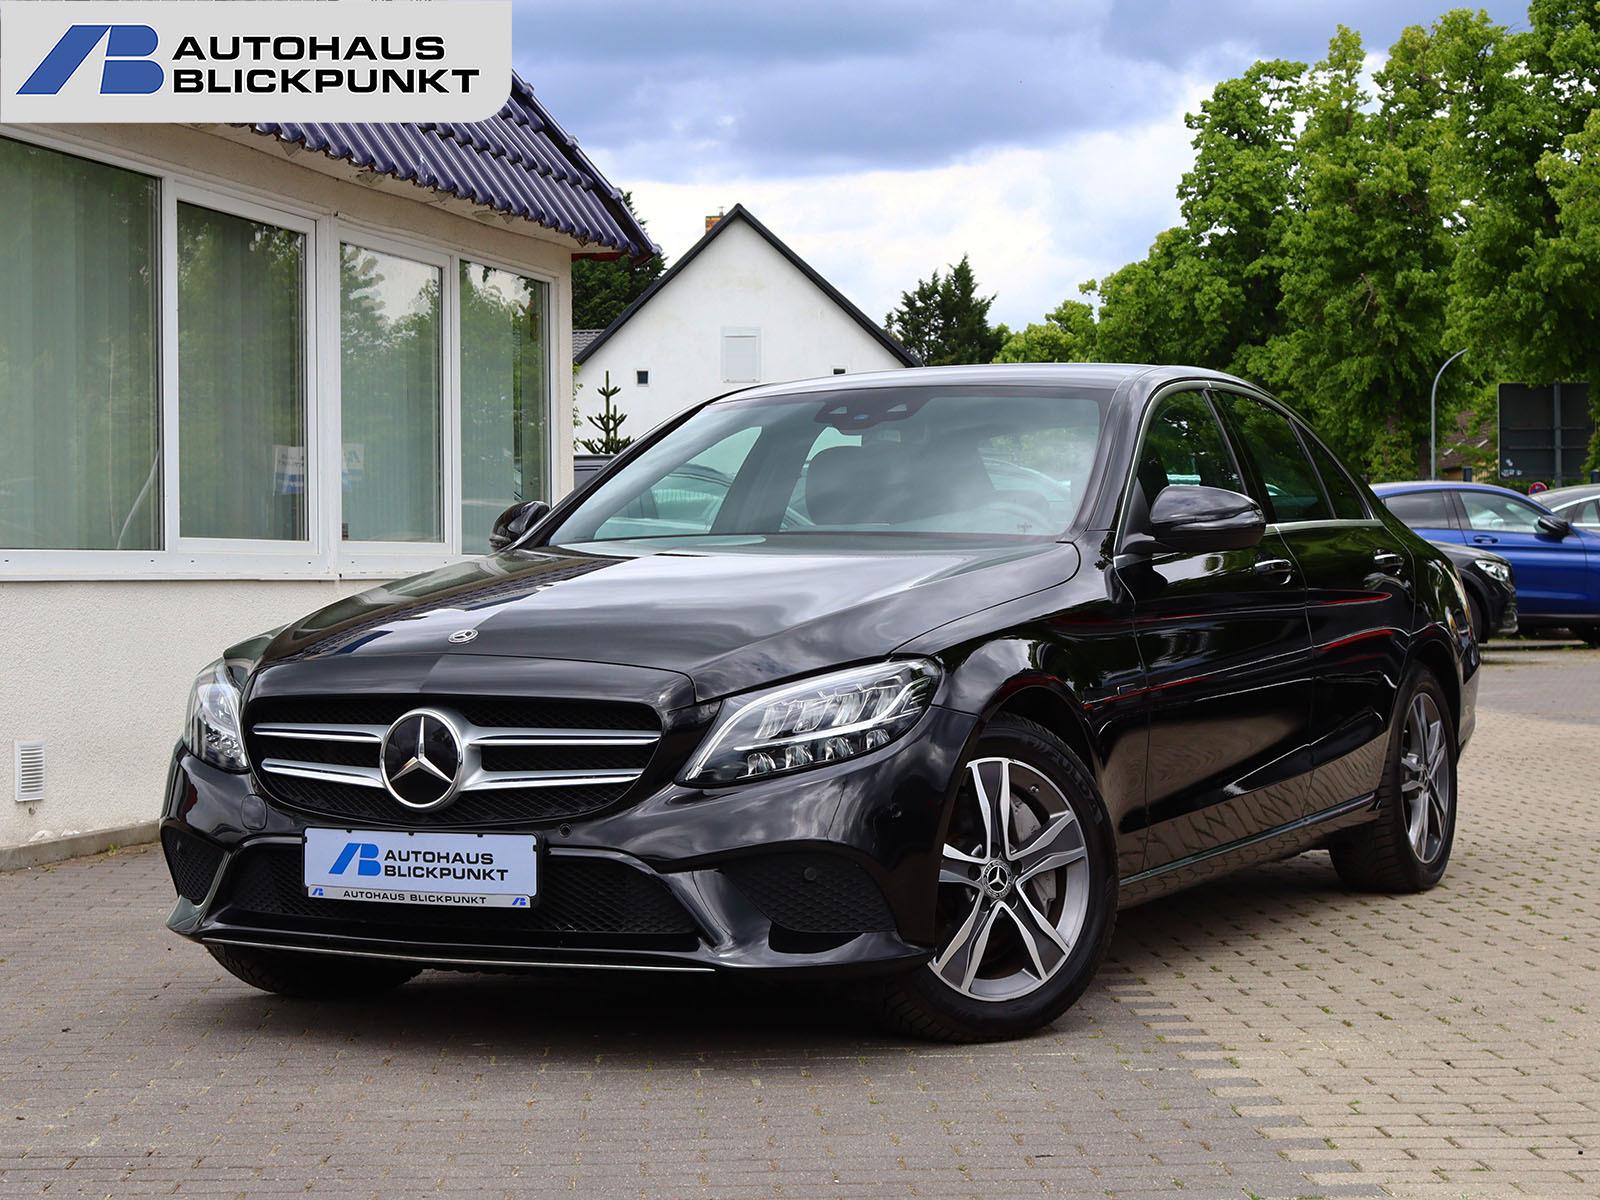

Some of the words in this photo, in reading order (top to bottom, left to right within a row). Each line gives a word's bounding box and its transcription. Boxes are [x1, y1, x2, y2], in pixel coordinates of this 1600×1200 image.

[384, 849, 494, 865] AUTOHAUS
[384, 865, 509, 881] BLICKPUNKT
[343, 890, 406, 901] AUTOHAUS
[409, 894, 487, 904] BLICKPUNKT
